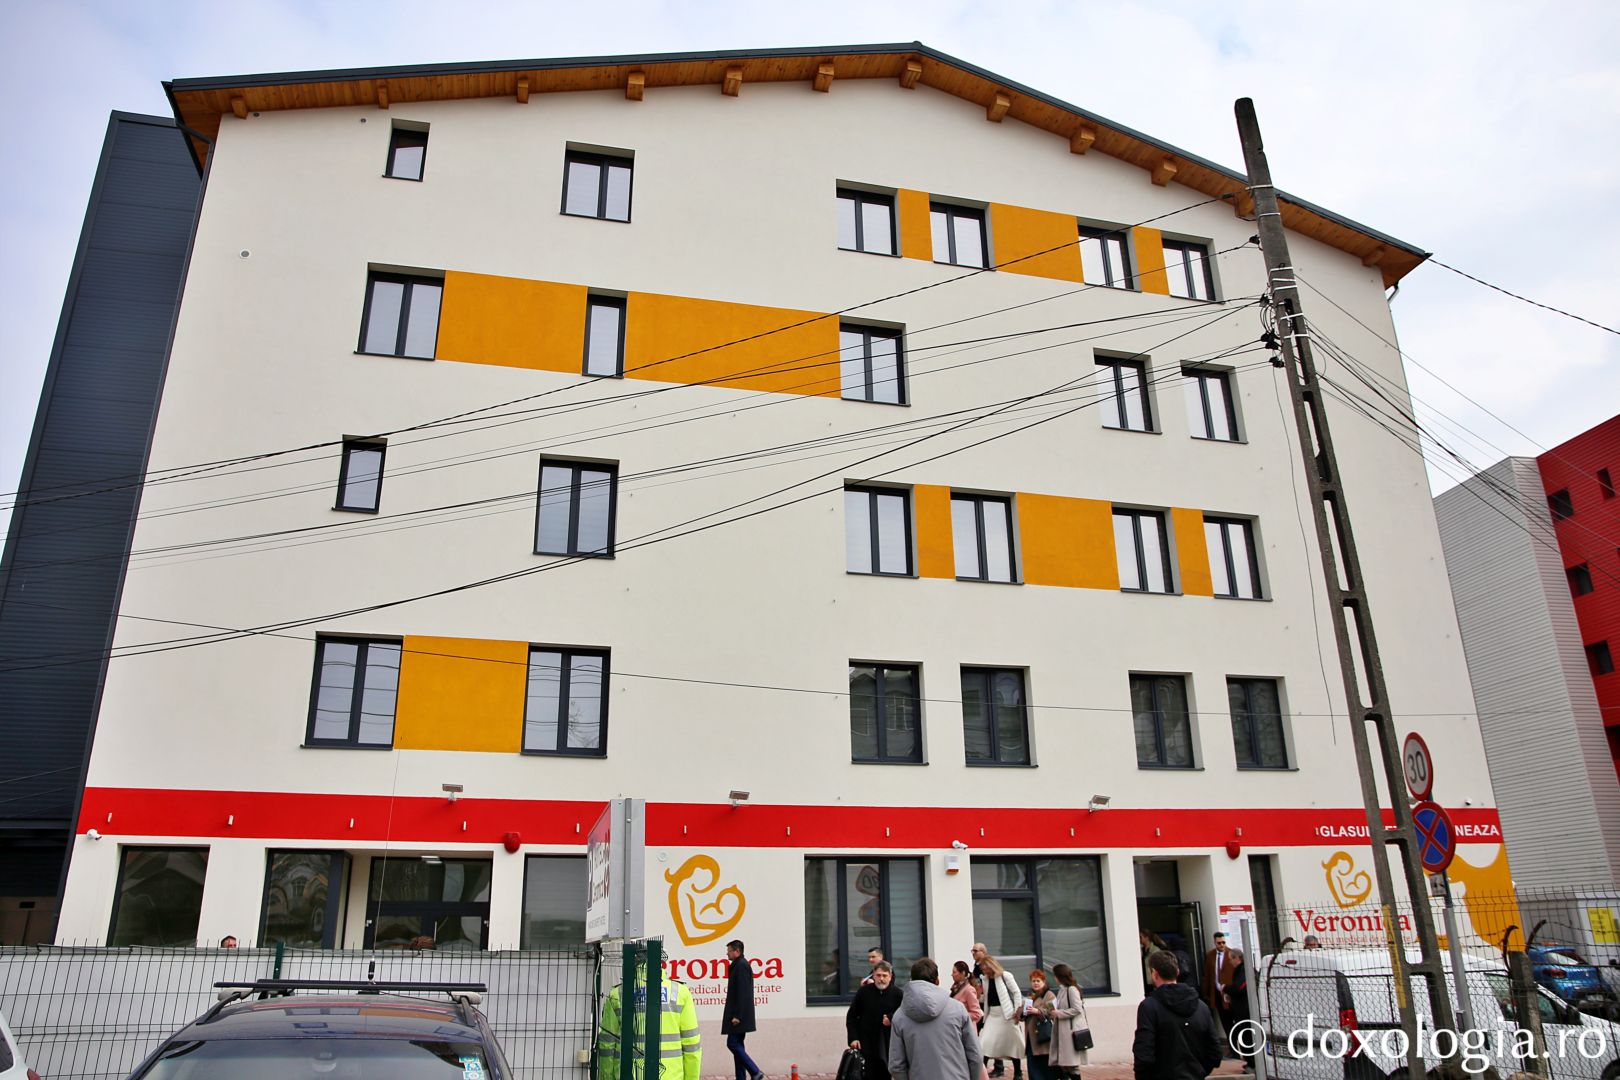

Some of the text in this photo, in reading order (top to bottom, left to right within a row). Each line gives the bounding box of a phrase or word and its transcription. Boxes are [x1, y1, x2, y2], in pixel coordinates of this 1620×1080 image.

[1407, 751, 1427, 784] 30
[1454, 824, 1500, 837] NEAZA
[1293, 909, 1412, 933] Veronia
[661, 957, 784, 980] ronca
[688, 984, 721, 995] edical
[754, 983, 782, 993] itate
[754, 995, 769, 1007] pii
